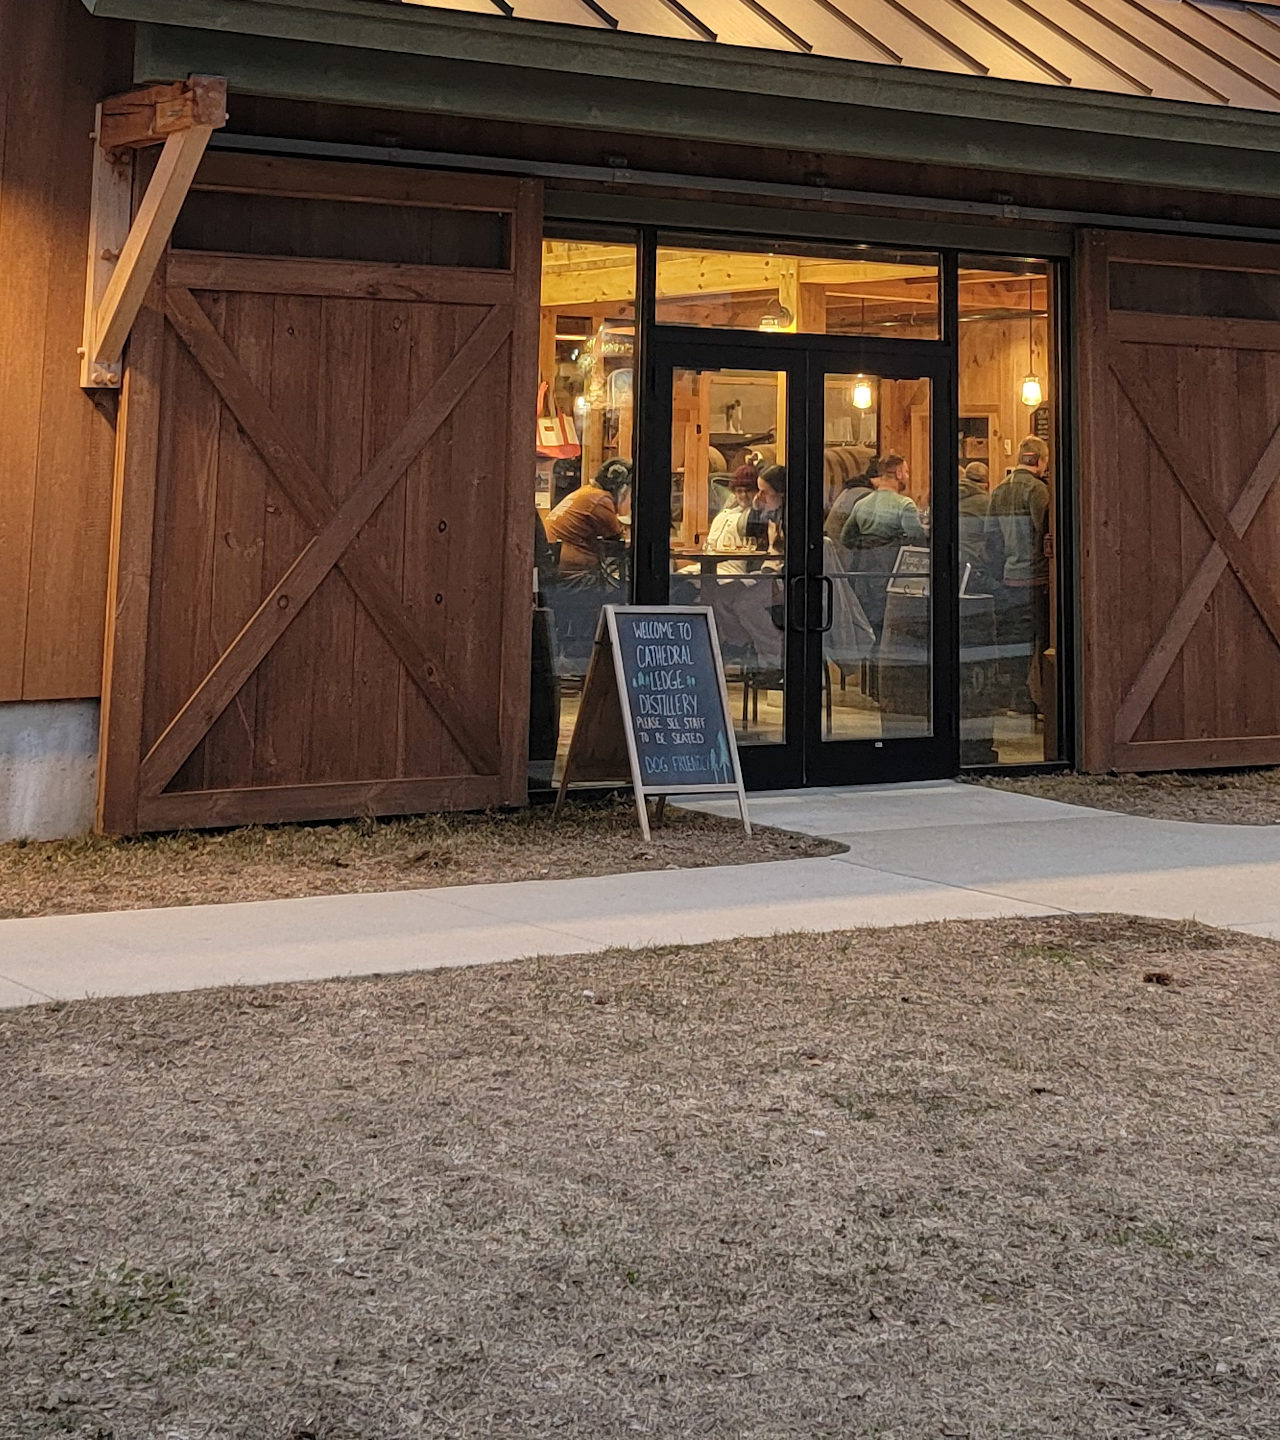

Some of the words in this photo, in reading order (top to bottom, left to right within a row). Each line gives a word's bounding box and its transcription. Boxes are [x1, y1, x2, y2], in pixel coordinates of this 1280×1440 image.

[632, 621, 675, 639] WELCOME
[676, 622, 692, 640] TO
[636, 645, 694, 668] CATHEDRAL
[649, 670, 685, 691] LEDGE
[639, 693, 698, 716] DISTILLERY
[636, 716, 663, 730] PLEASE
[666, 717, 681, 730] SEE
[683, 717, 706, 730] STAFF
[639, 731, 650, 743] TO
[655, 732, 668, 745] BE
[671, 732, 705, 745] SEATED
[644, 755, 669, 774] DOG
